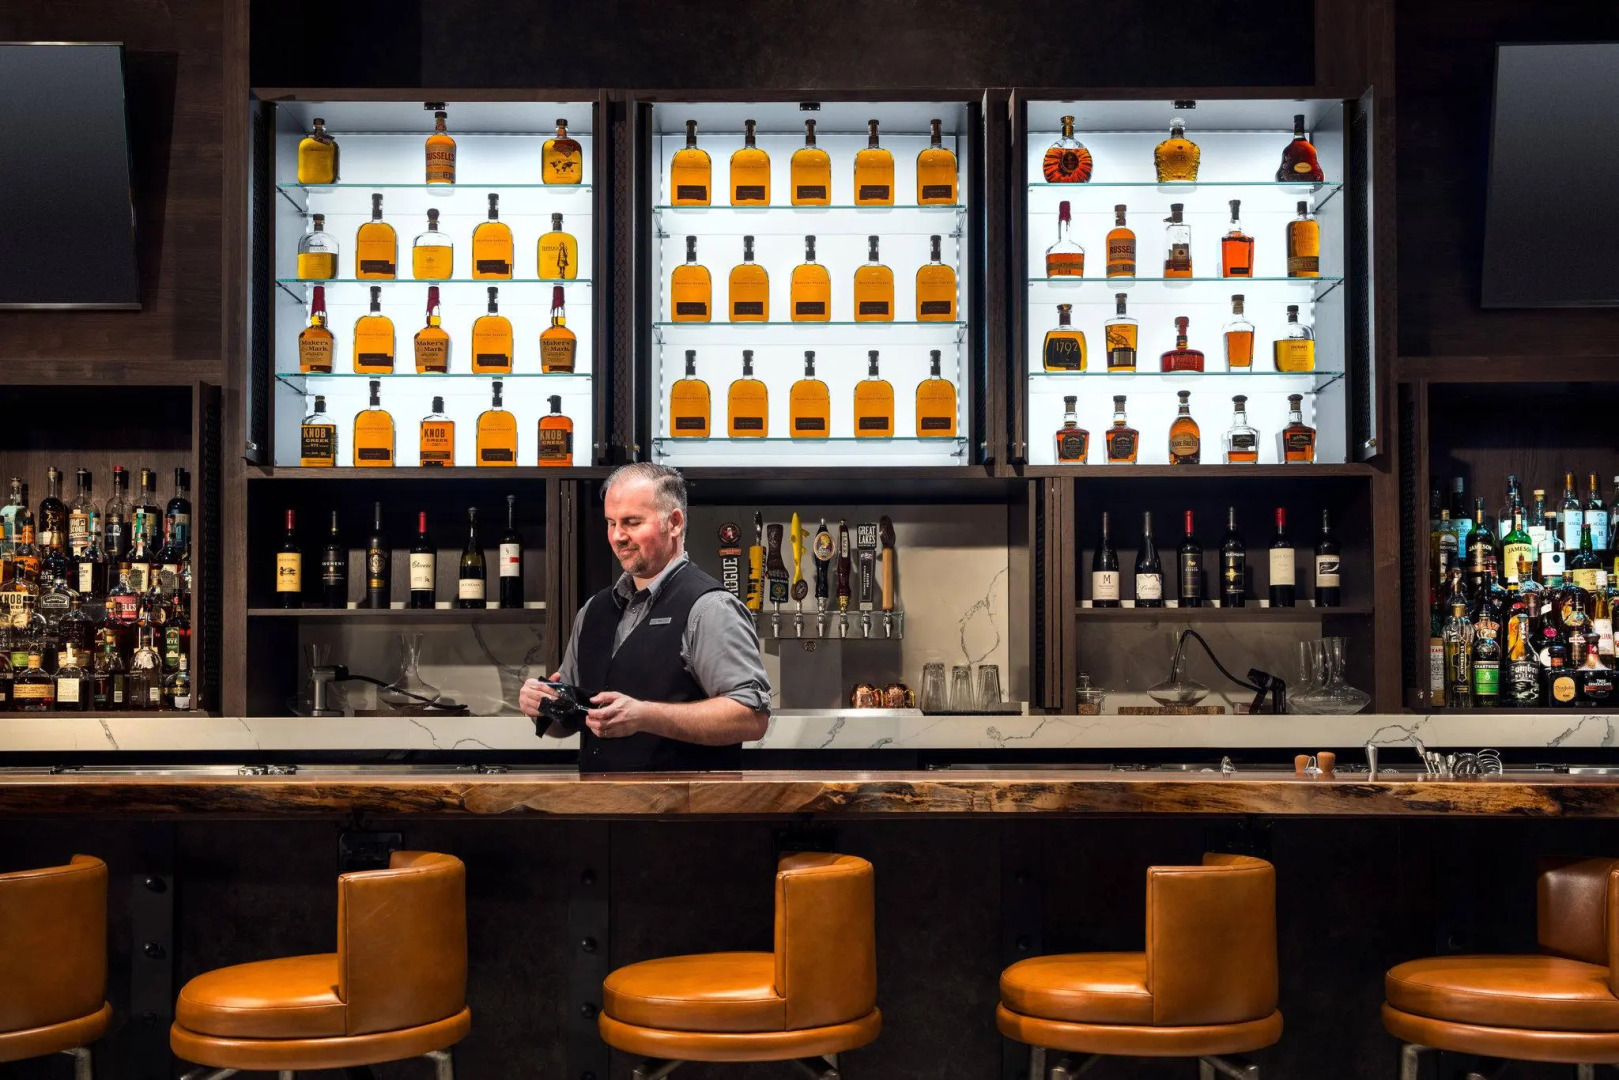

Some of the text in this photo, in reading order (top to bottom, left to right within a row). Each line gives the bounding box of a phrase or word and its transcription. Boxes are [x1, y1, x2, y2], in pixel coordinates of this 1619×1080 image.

[1056, 341, 1078, 355] 1792
[303, 427, 327, 438] KNOB
[424, 428, 446, 438] KNOB
[540, 429, 562, 440] KNOB
[858, 525, 876, 535] GREAT
[858, 534, 876, 544] LAKES
